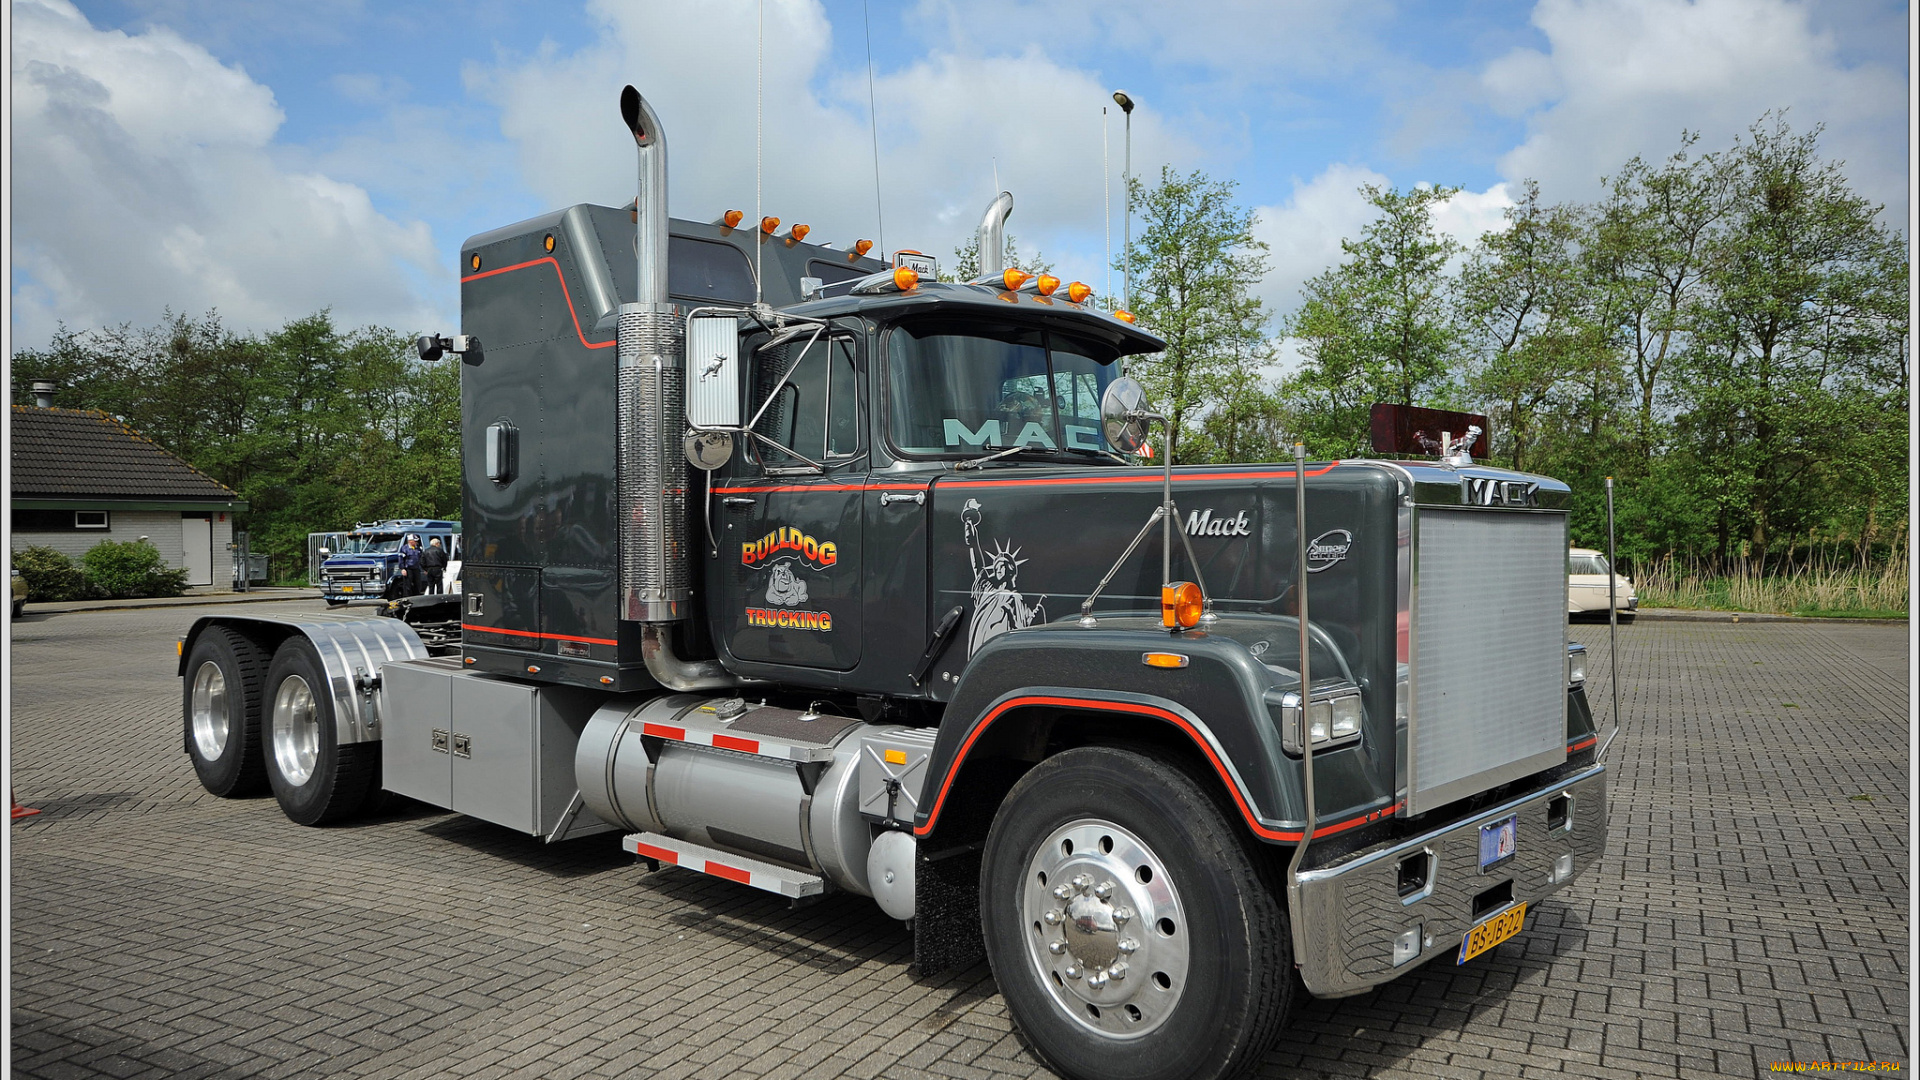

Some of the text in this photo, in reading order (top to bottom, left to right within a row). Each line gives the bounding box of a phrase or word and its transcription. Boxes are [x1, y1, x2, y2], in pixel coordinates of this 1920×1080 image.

[911, 262, 929, 274] Mack
[943, 418, 1116, 453] MAC
[1460, 478, 1540, 507] MACK
[1185, 508, 1251, 536] Mack
[742, 526, 837, 565] BULLDOG
[746, 607, 832, 631] TRUCKING
